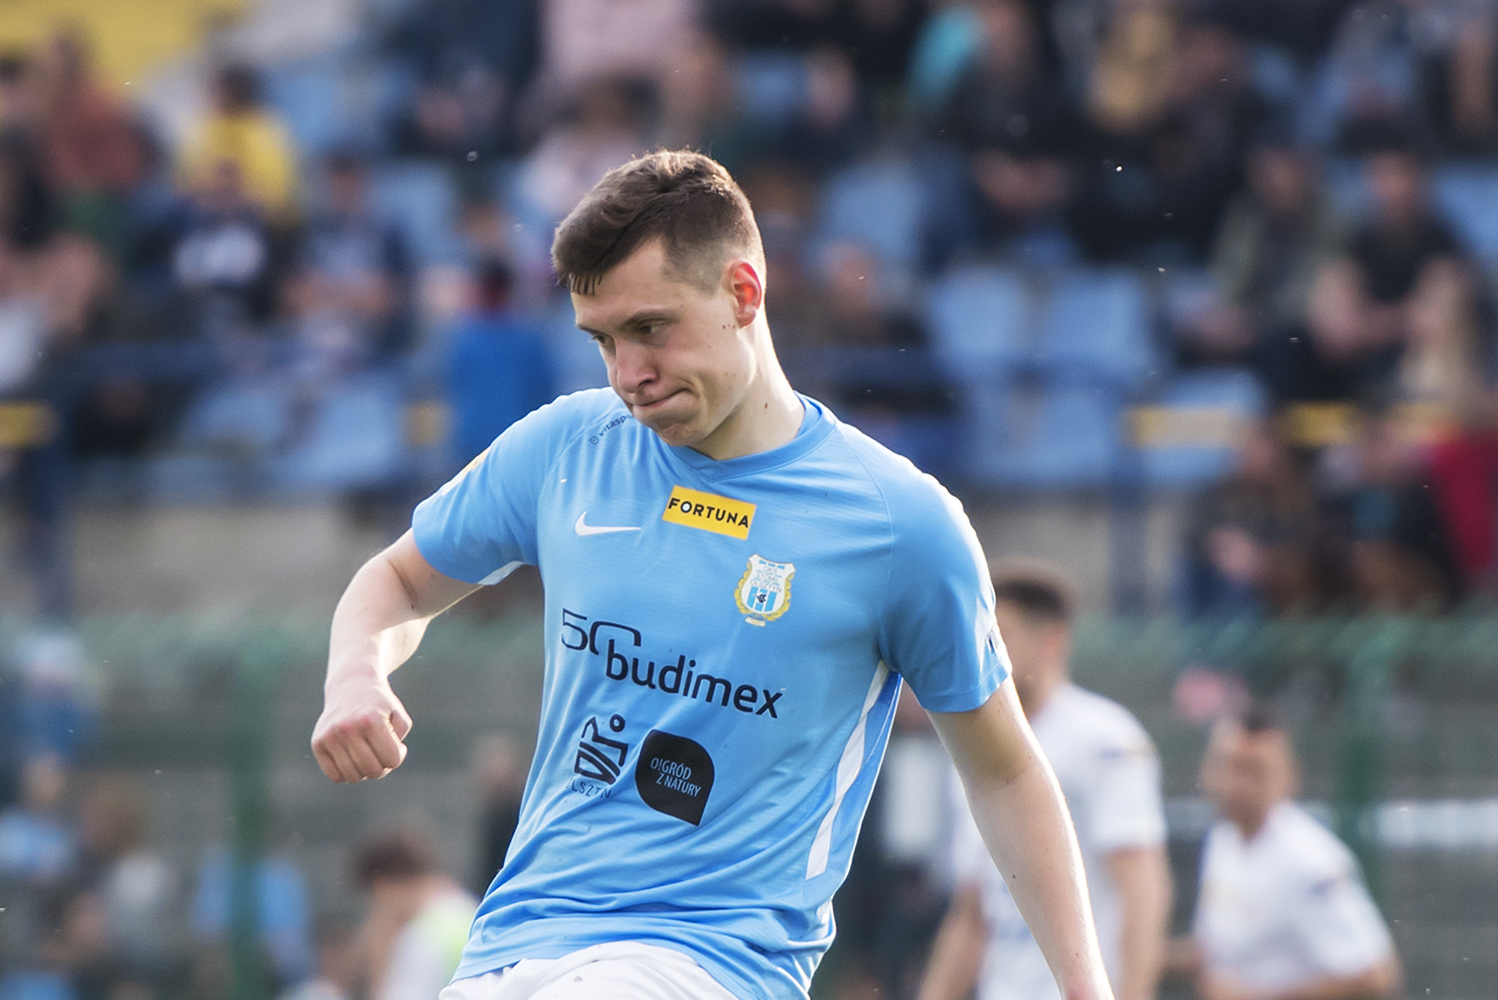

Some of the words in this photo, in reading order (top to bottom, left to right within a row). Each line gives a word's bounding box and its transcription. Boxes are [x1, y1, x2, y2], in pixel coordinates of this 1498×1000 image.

[668, 497, 749, 529] FORTUNA
[606, 639, 783, 719] budimex
[650, 757, 692, 780] O!GRÓD
[656, 774, 665, 785] Z
[664, 776, 702, 798] NATURY
